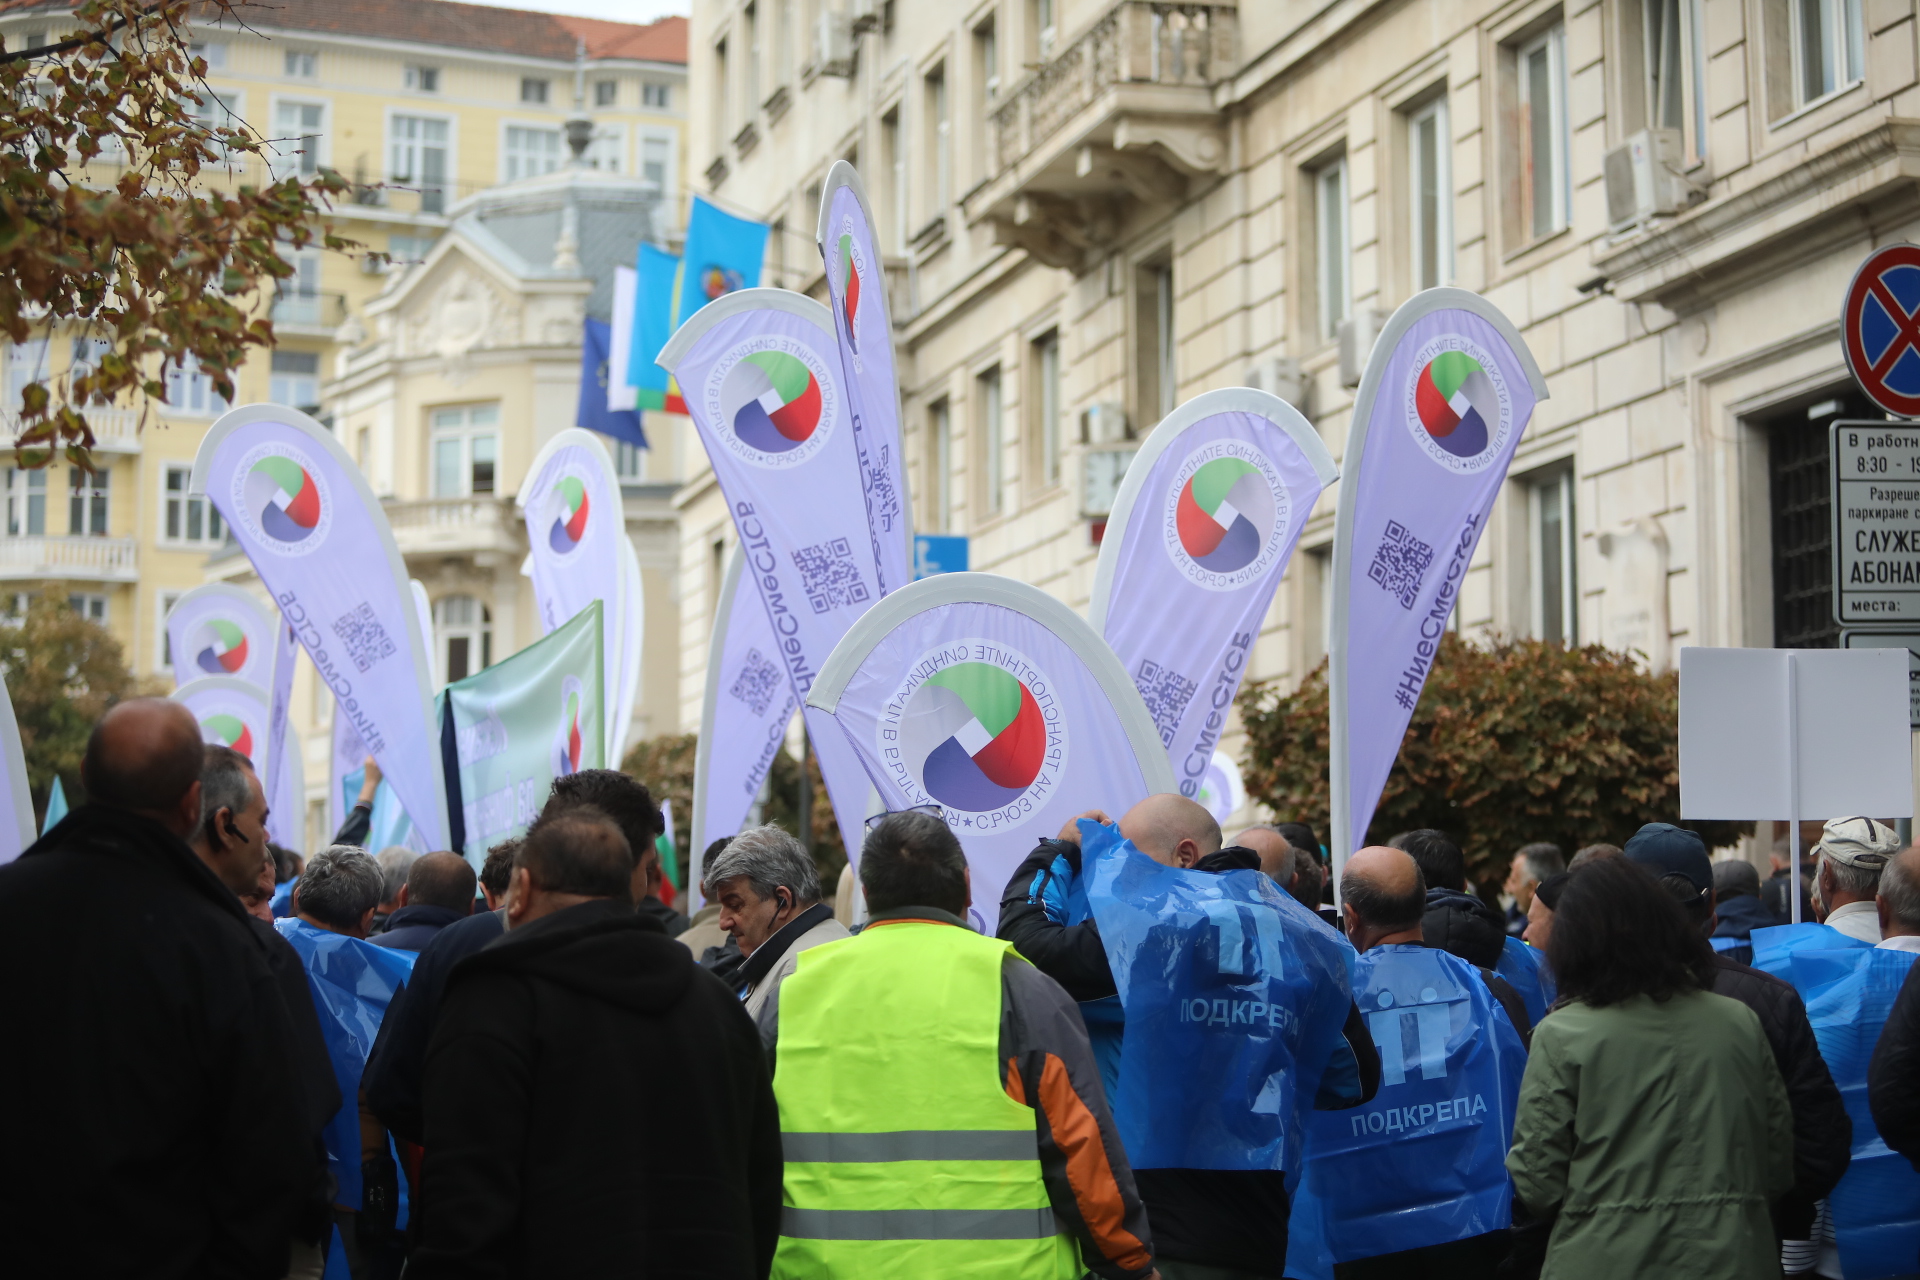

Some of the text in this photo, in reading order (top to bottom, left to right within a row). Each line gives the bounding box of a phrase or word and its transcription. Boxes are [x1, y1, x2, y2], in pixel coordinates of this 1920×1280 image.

[1500, 407, 1509, 416] В
[1414, 424, 1430, 444] НА
[1849, 433, 1919, 451] В работн
[1469, 420, 1509, 470] БЪЛГАРИЯ
[1428, 443, 1461, 469] СЪЮЗ
[1857, 456, 1888, 473] 8:30
[1870, 486, 1920, 504] Разреше
[1166, 443, 1287, 587] СЪЮЗ НА ТРАНСПОРТНИТЕ СИНДИКАТИ В БЪЛГАРИЯ
[1848, 507, 1909, 523] паркиране
[1855, 530, 1920, 553] СЛУЖЕ
[1851, 601, 1901, 612] места:
[1180, 998, 1299, 1036] ПОДКРЕПА
[1350, 1093, 1488, 1137] ПОДКРЕПА
